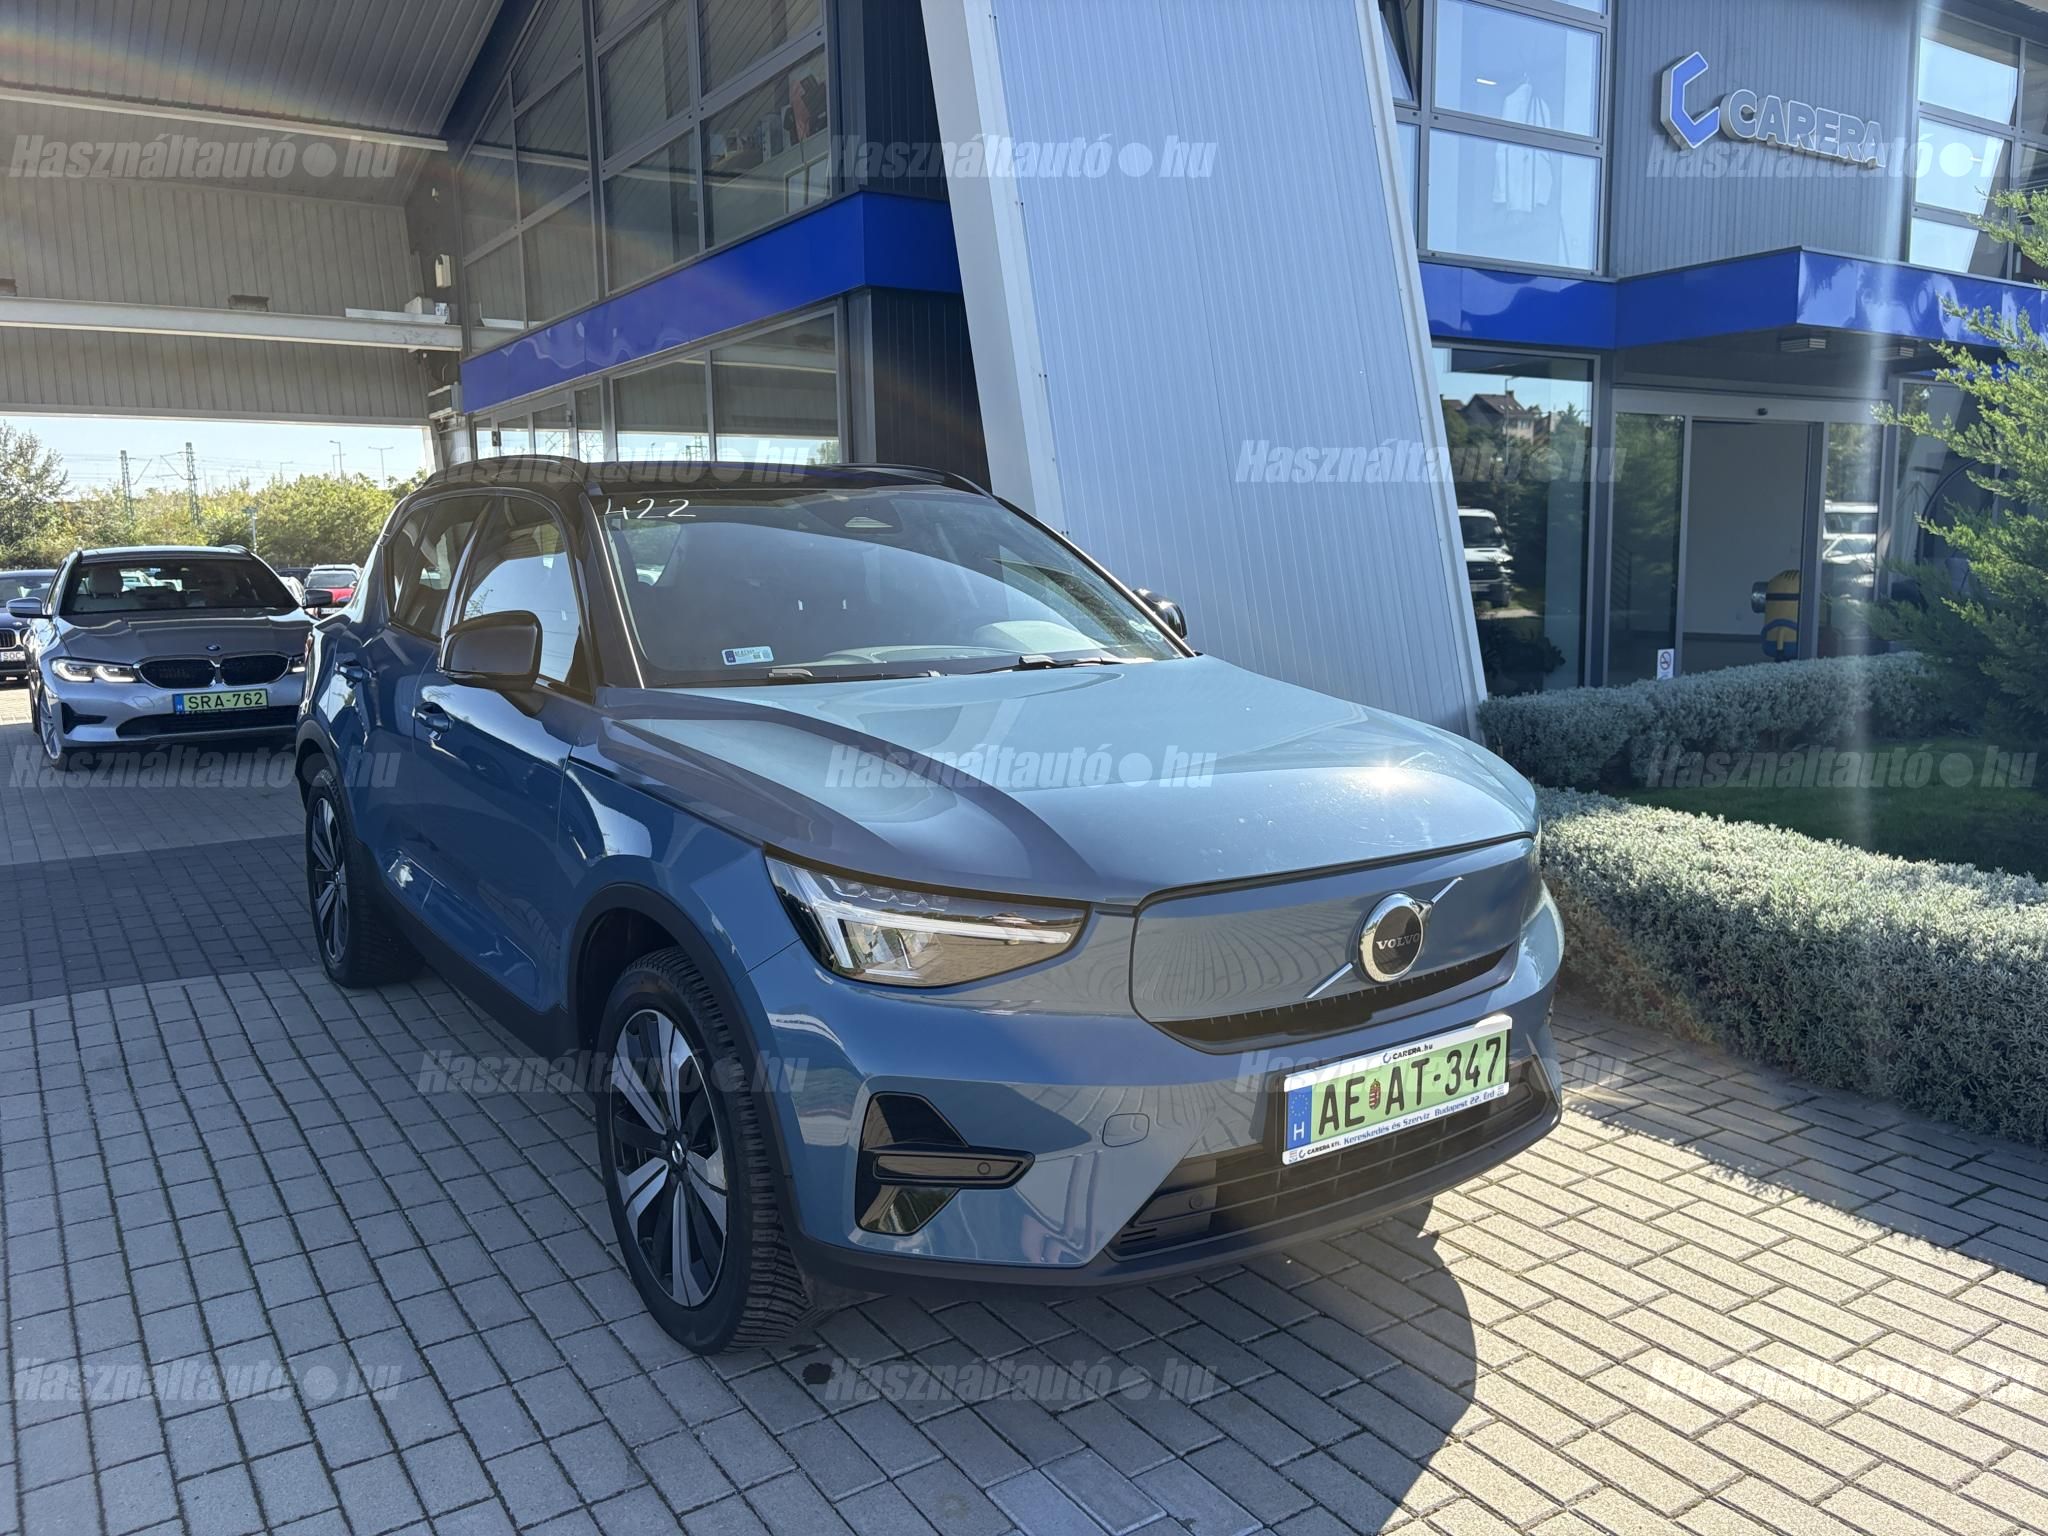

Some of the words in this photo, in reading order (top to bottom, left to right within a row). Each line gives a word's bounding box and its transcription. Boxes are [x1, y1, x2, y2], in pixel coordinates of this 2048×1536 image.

[1724, 88, 1887, 168] CARERA
[605, 498, 697, 520] 422
[188, 692, 263, 710] SRA-762
[1376, 933, 1420, 950] VOLVO
[1318, 1076, 1366, 1136] AE
[1293, 1122, 1305, 1141] H
[1343, 1124, 1390, 1145] Kereskedés
[1391, 1122, 1401, 1131] és
[1402, 1112, 1430, 1126] Szerviz
[1434, 1100, 1468, 1116] Budapest
